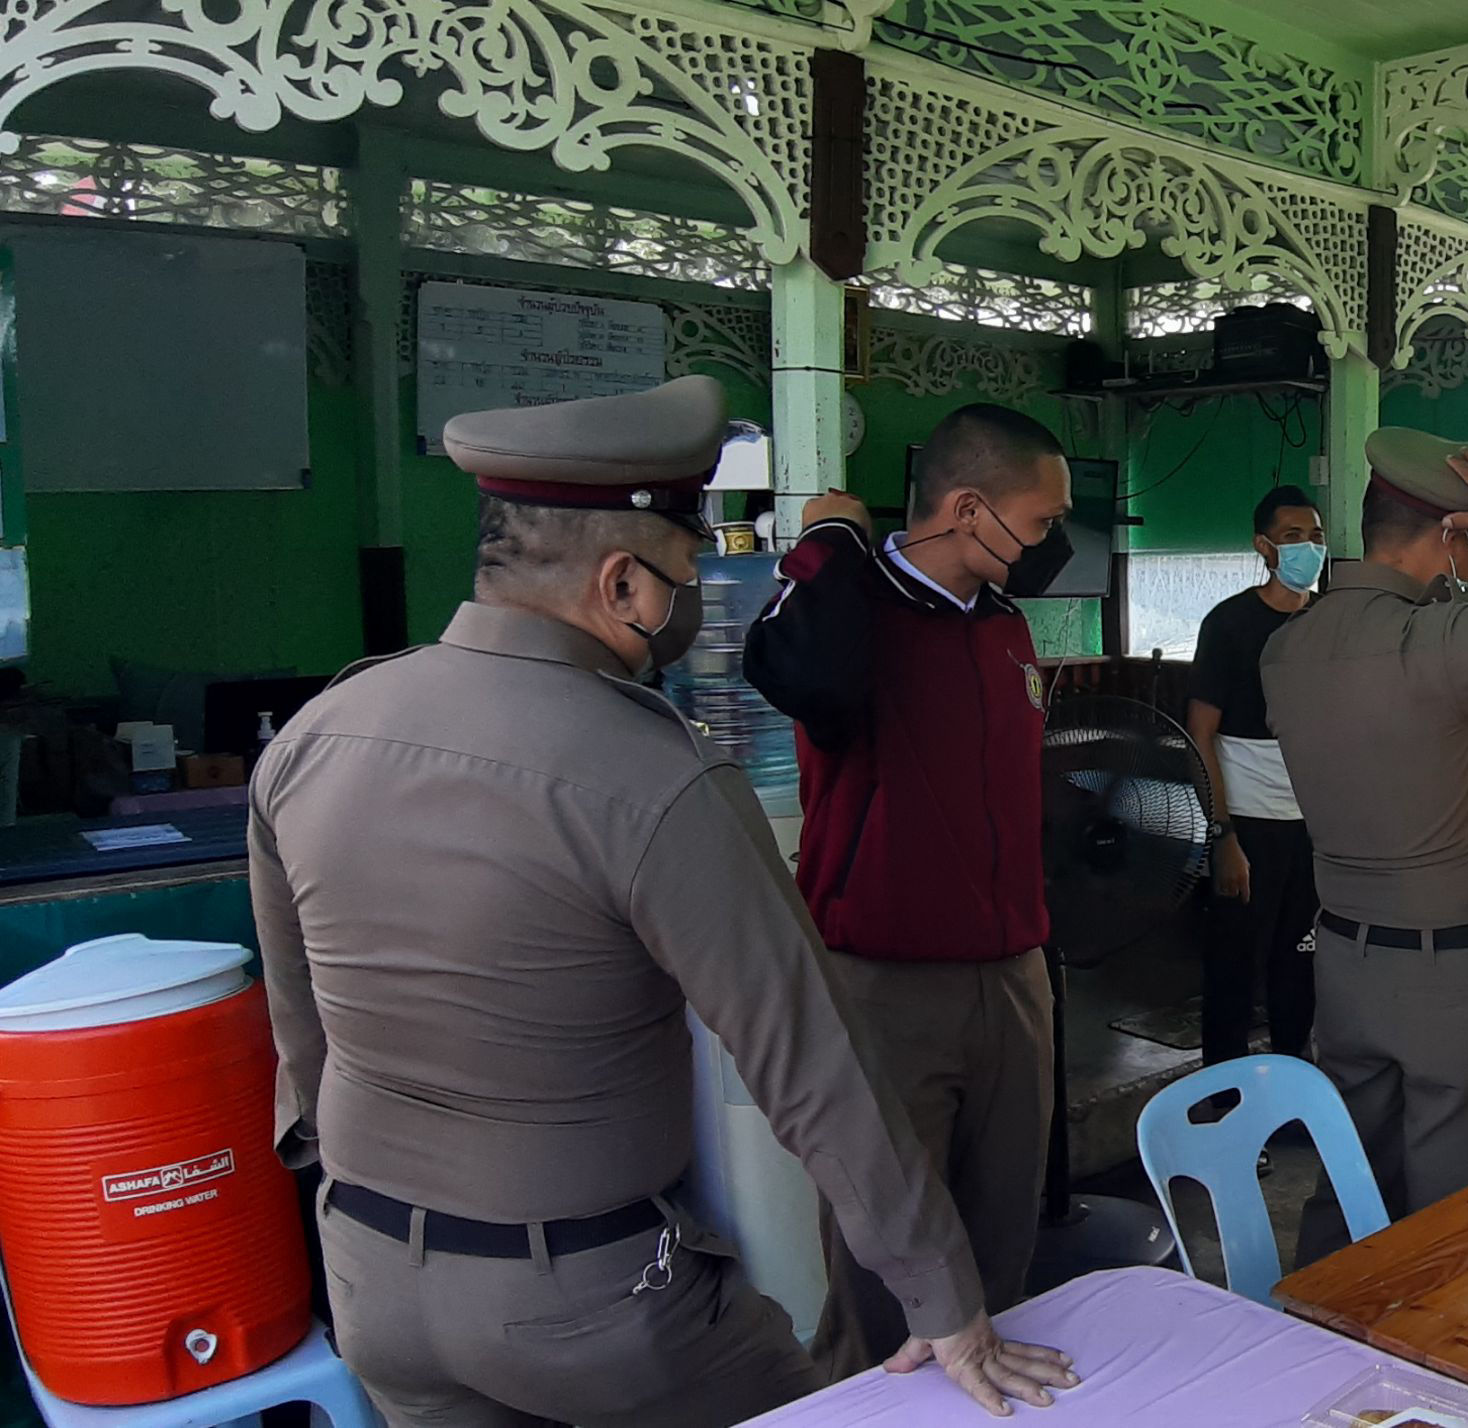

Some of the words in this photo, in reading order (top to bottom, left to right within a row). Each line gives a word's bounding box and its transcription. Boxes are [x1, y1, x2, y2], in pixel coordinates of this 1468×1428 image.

[109, 1175, 161, 1194] ASHAFA
[134, 1198, 184, 1217] DRINKING
[185, 1189, 218, 1204] WATER
